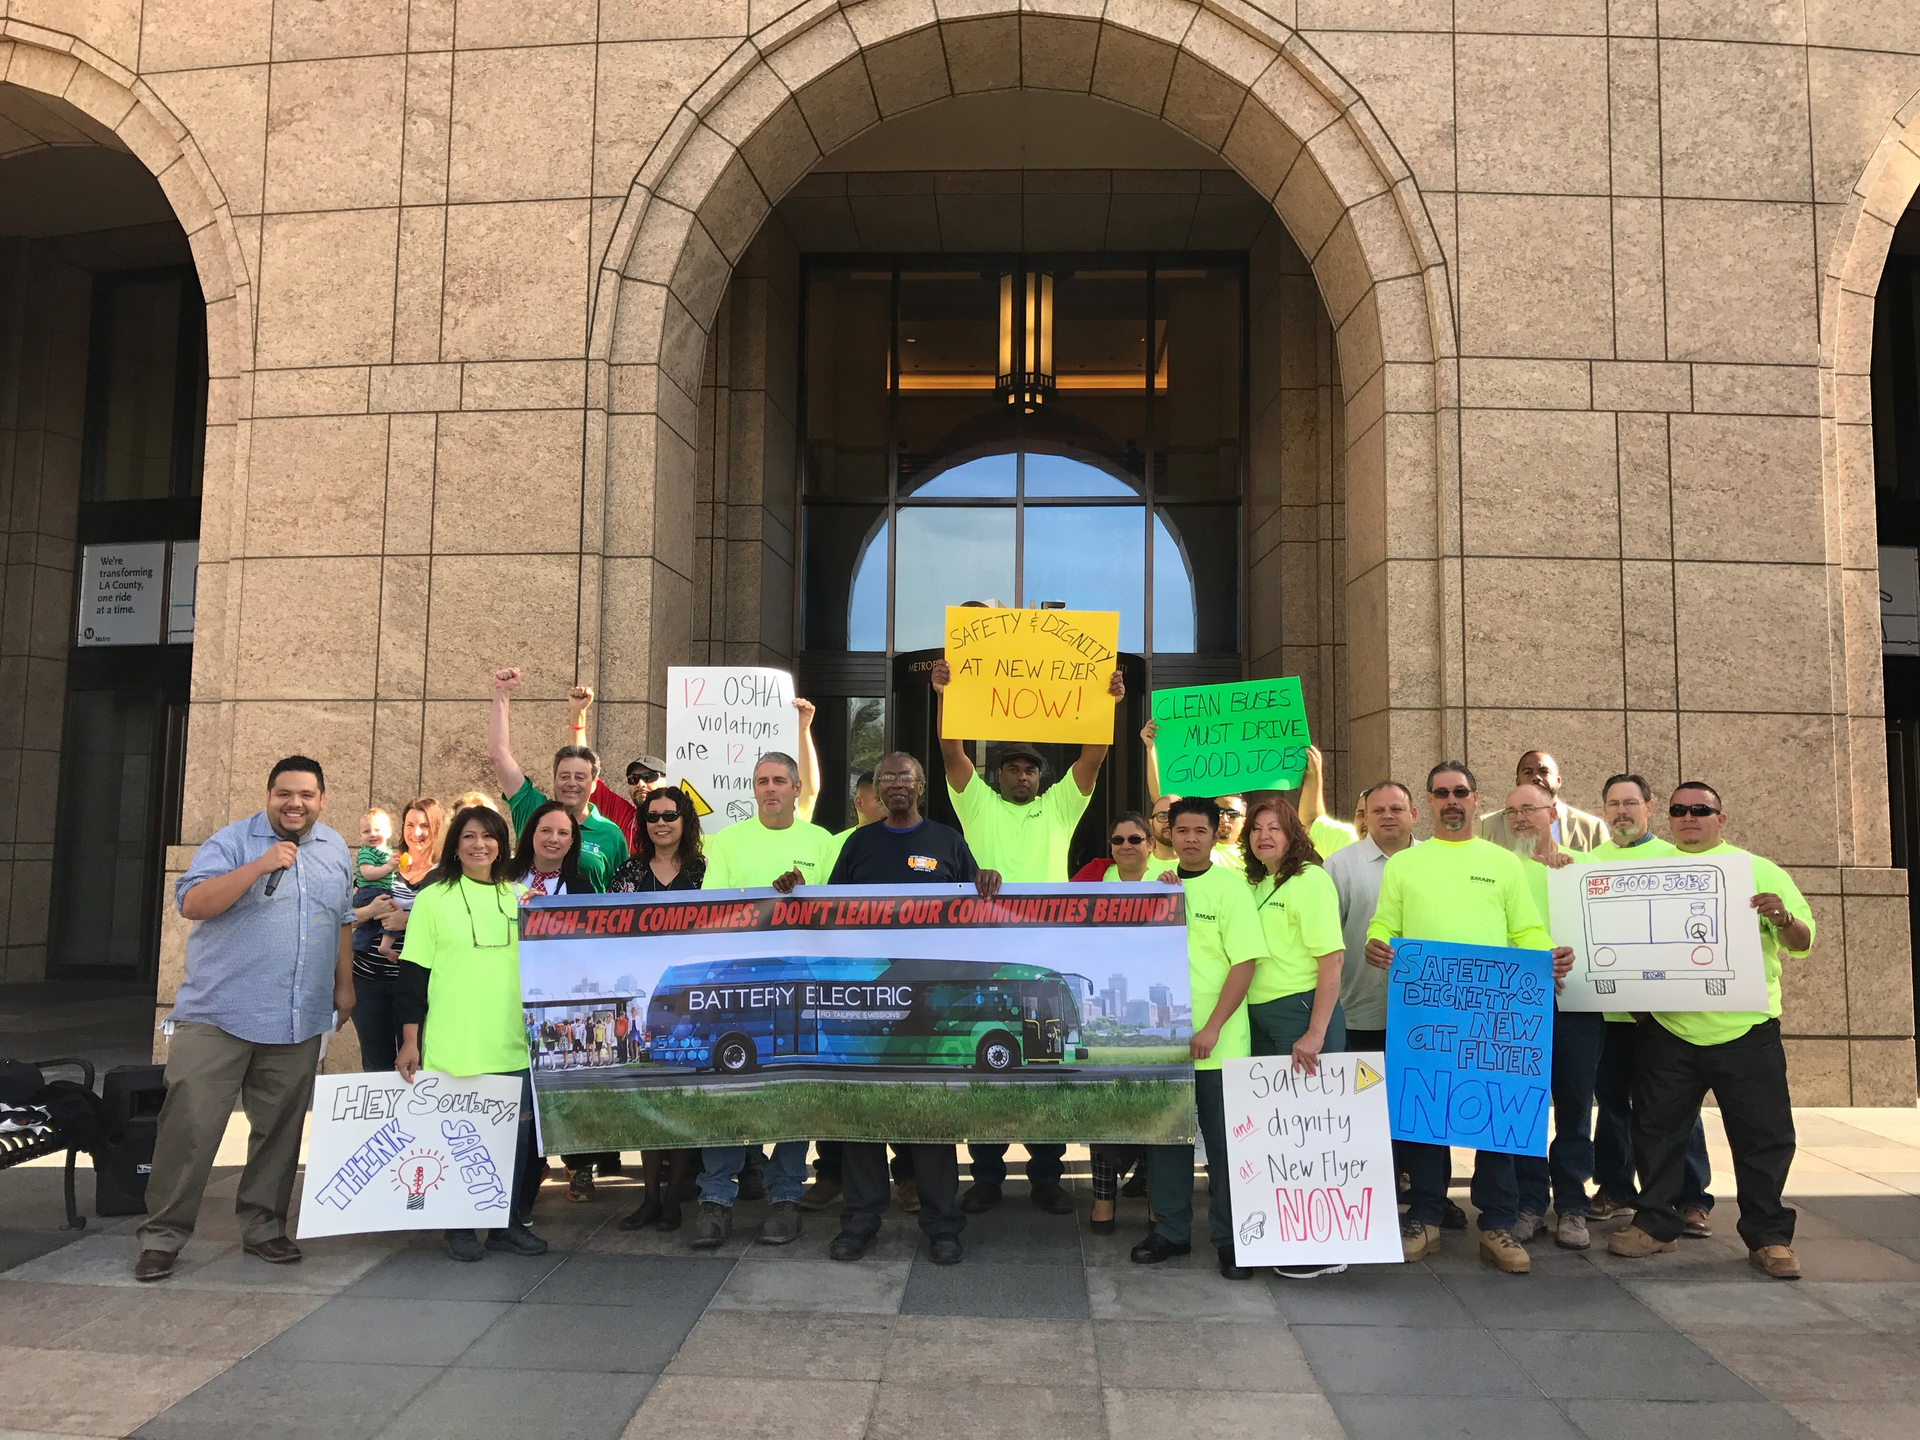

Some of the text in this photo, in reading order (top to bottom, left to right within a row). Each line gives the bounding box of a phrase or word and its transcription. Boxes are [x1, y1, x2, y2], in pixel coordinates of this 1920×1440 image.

[99, 567, 153, 578] transforming
[100, 556, 123, 566] We're
[97, 592, 131, 602] one ride
[98, 581, 144, 591] LA County,
[96, 606, 105, 614] at
[114, 605, 135, 614] time.
[949, 611, 1022, 649] SAFETY
[1040, 613, 1114, 663] DIGNITY
[908, 660, 938, 672] METROP
[959, 658, 983, 676] AT
[994, 659, 1044, 678] NEW
[1050, 659, 1098, 681] FLYER
[684, 674, 782, 708] 12 OSHA
[990, 685, 1082, 720] NOW!
[1155, 688, 1291, 720] CLEAN BUSES
[697, 711, 779, 740] violations
[1183, 719, 1307, 747] MUST DRIVE
[675, 741, 709, 760] are
[726, 743, 746, 765] 12
[1166, 745, 1309, 783] GOOD JOBS
[1470, 875, 1496, 884] SMART
[1588, 877, 1610, 887] NEXT
[1588, 885, 1610, 896] STOP
[1612, 873, 1711, 892] GOOD JOBS
[524, 896, 1178, 936] HIGH-TECH COMPANIES: DON'T LEAVE OUR COMMUNITIES BEHIND!
[1393, 943, 1545, 1006] SAFETY &
[688, 985, 912, 1011] BATTERY ELECTRIC
[1403, 982, 1516, 1010] DIGNITY
[833, 1010, 861, 1019] TAILPIPE
[862, 1011, 901, 1019] EMISSIONS
[1469, 1011, 1543, 1042] NEW
[1457, 1039, 1543, 1077] FLYER
[1249, 1059, 1345, 1099] Safety
[332, 1077, 517, 1126] HEY Soubry,
[1398, 1067, 1547, 1149] NOW
[1232, 1107, 1351, 1148] and dignity
[315, 1117, 416, 1211] THINK
[440, 1119, 509, 1211] SAFETY
[1239, 1150, 1369, 1187] at New Flyer
[1276, 1187, 1373, 1243] NOW
